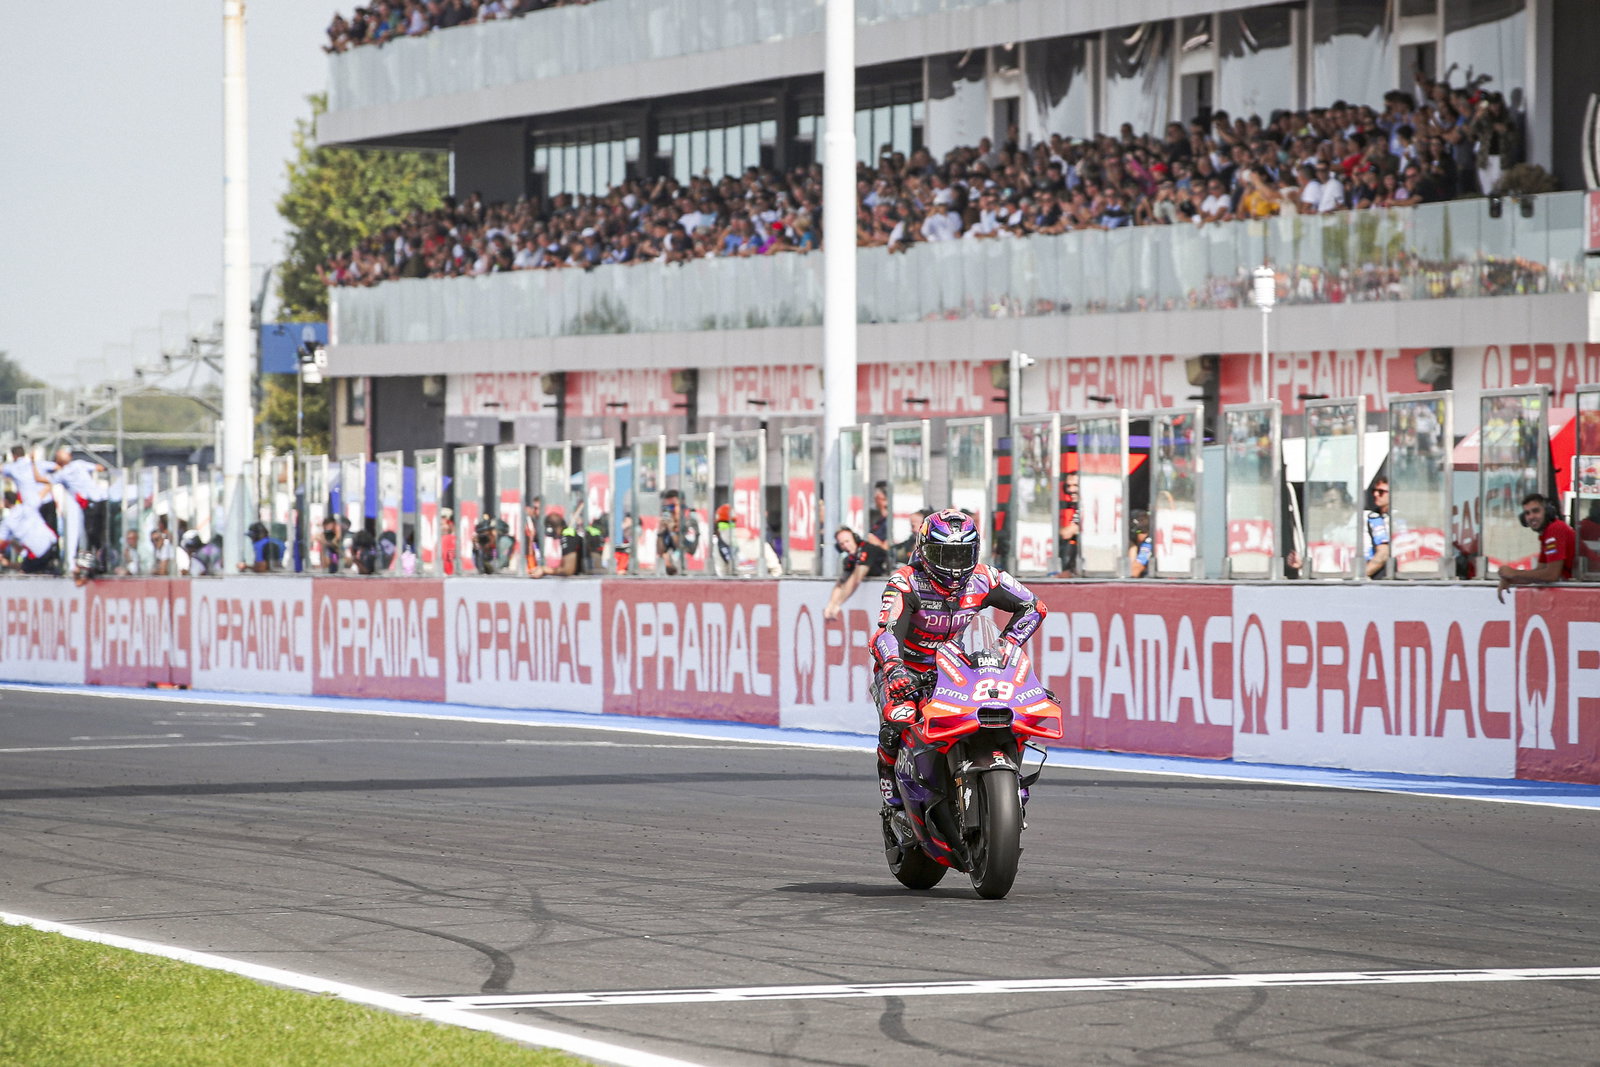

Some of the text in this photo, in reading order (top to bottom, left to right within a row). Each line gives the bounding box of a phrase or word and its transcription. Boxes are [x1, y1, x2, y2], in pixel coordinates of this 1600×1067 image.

[732, 364, 814, 411] PRAMAC
[887, 361, 983, 411] PRAMAC
[1067, 355, 1173, 409] PRAMAC
[1273, 350, 1400, 413] PRAMAC
[7, 597, 78, 662] PRAMAC
[105, 596, 188, 669] PRAMAC
[216, 599, 304, 673] PRAMAC
[337, 598, 440, 678] PRAMAC
[477, 601, 592, 685] PRAMAC
[636, 602, 772, 697] PRAMAC
[936, 686, 970, 702] prima
[972, 678, 1016, 701] 89
[1014, 686, 1043, 704] prima
[1043, 612, 1233, 726] PRAMAC
[1282, 621, 1510, 739] PRAMAC
